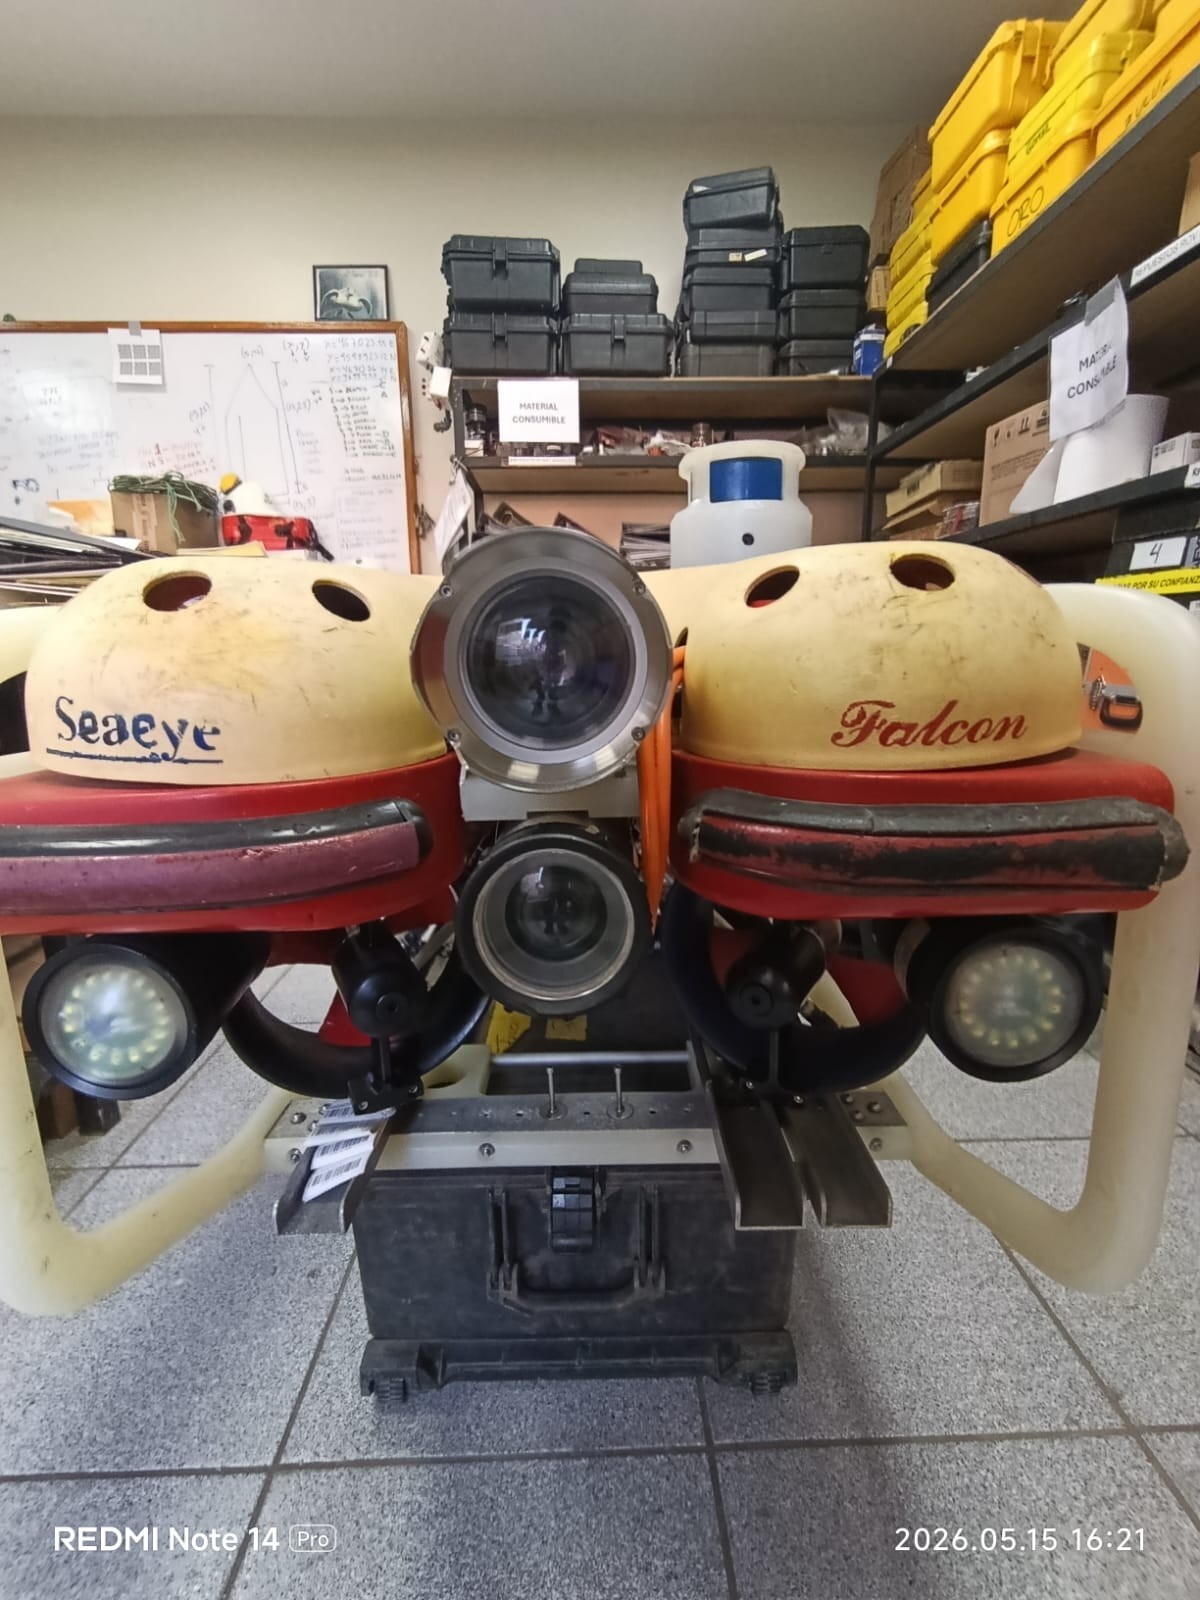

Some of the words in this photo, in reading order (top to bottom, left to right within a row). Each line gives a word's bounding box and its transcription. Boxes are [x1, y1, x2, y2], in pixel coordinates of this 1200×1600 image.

[519, 402, 558, 411] MATERIAL
[512, 415, 566, 425] CONSUMIBLE
[1149, 542, 1163, 564] 4
[55, 695, 221, 761] Seaeye
[830, 699, 1028, 748] Falcon
